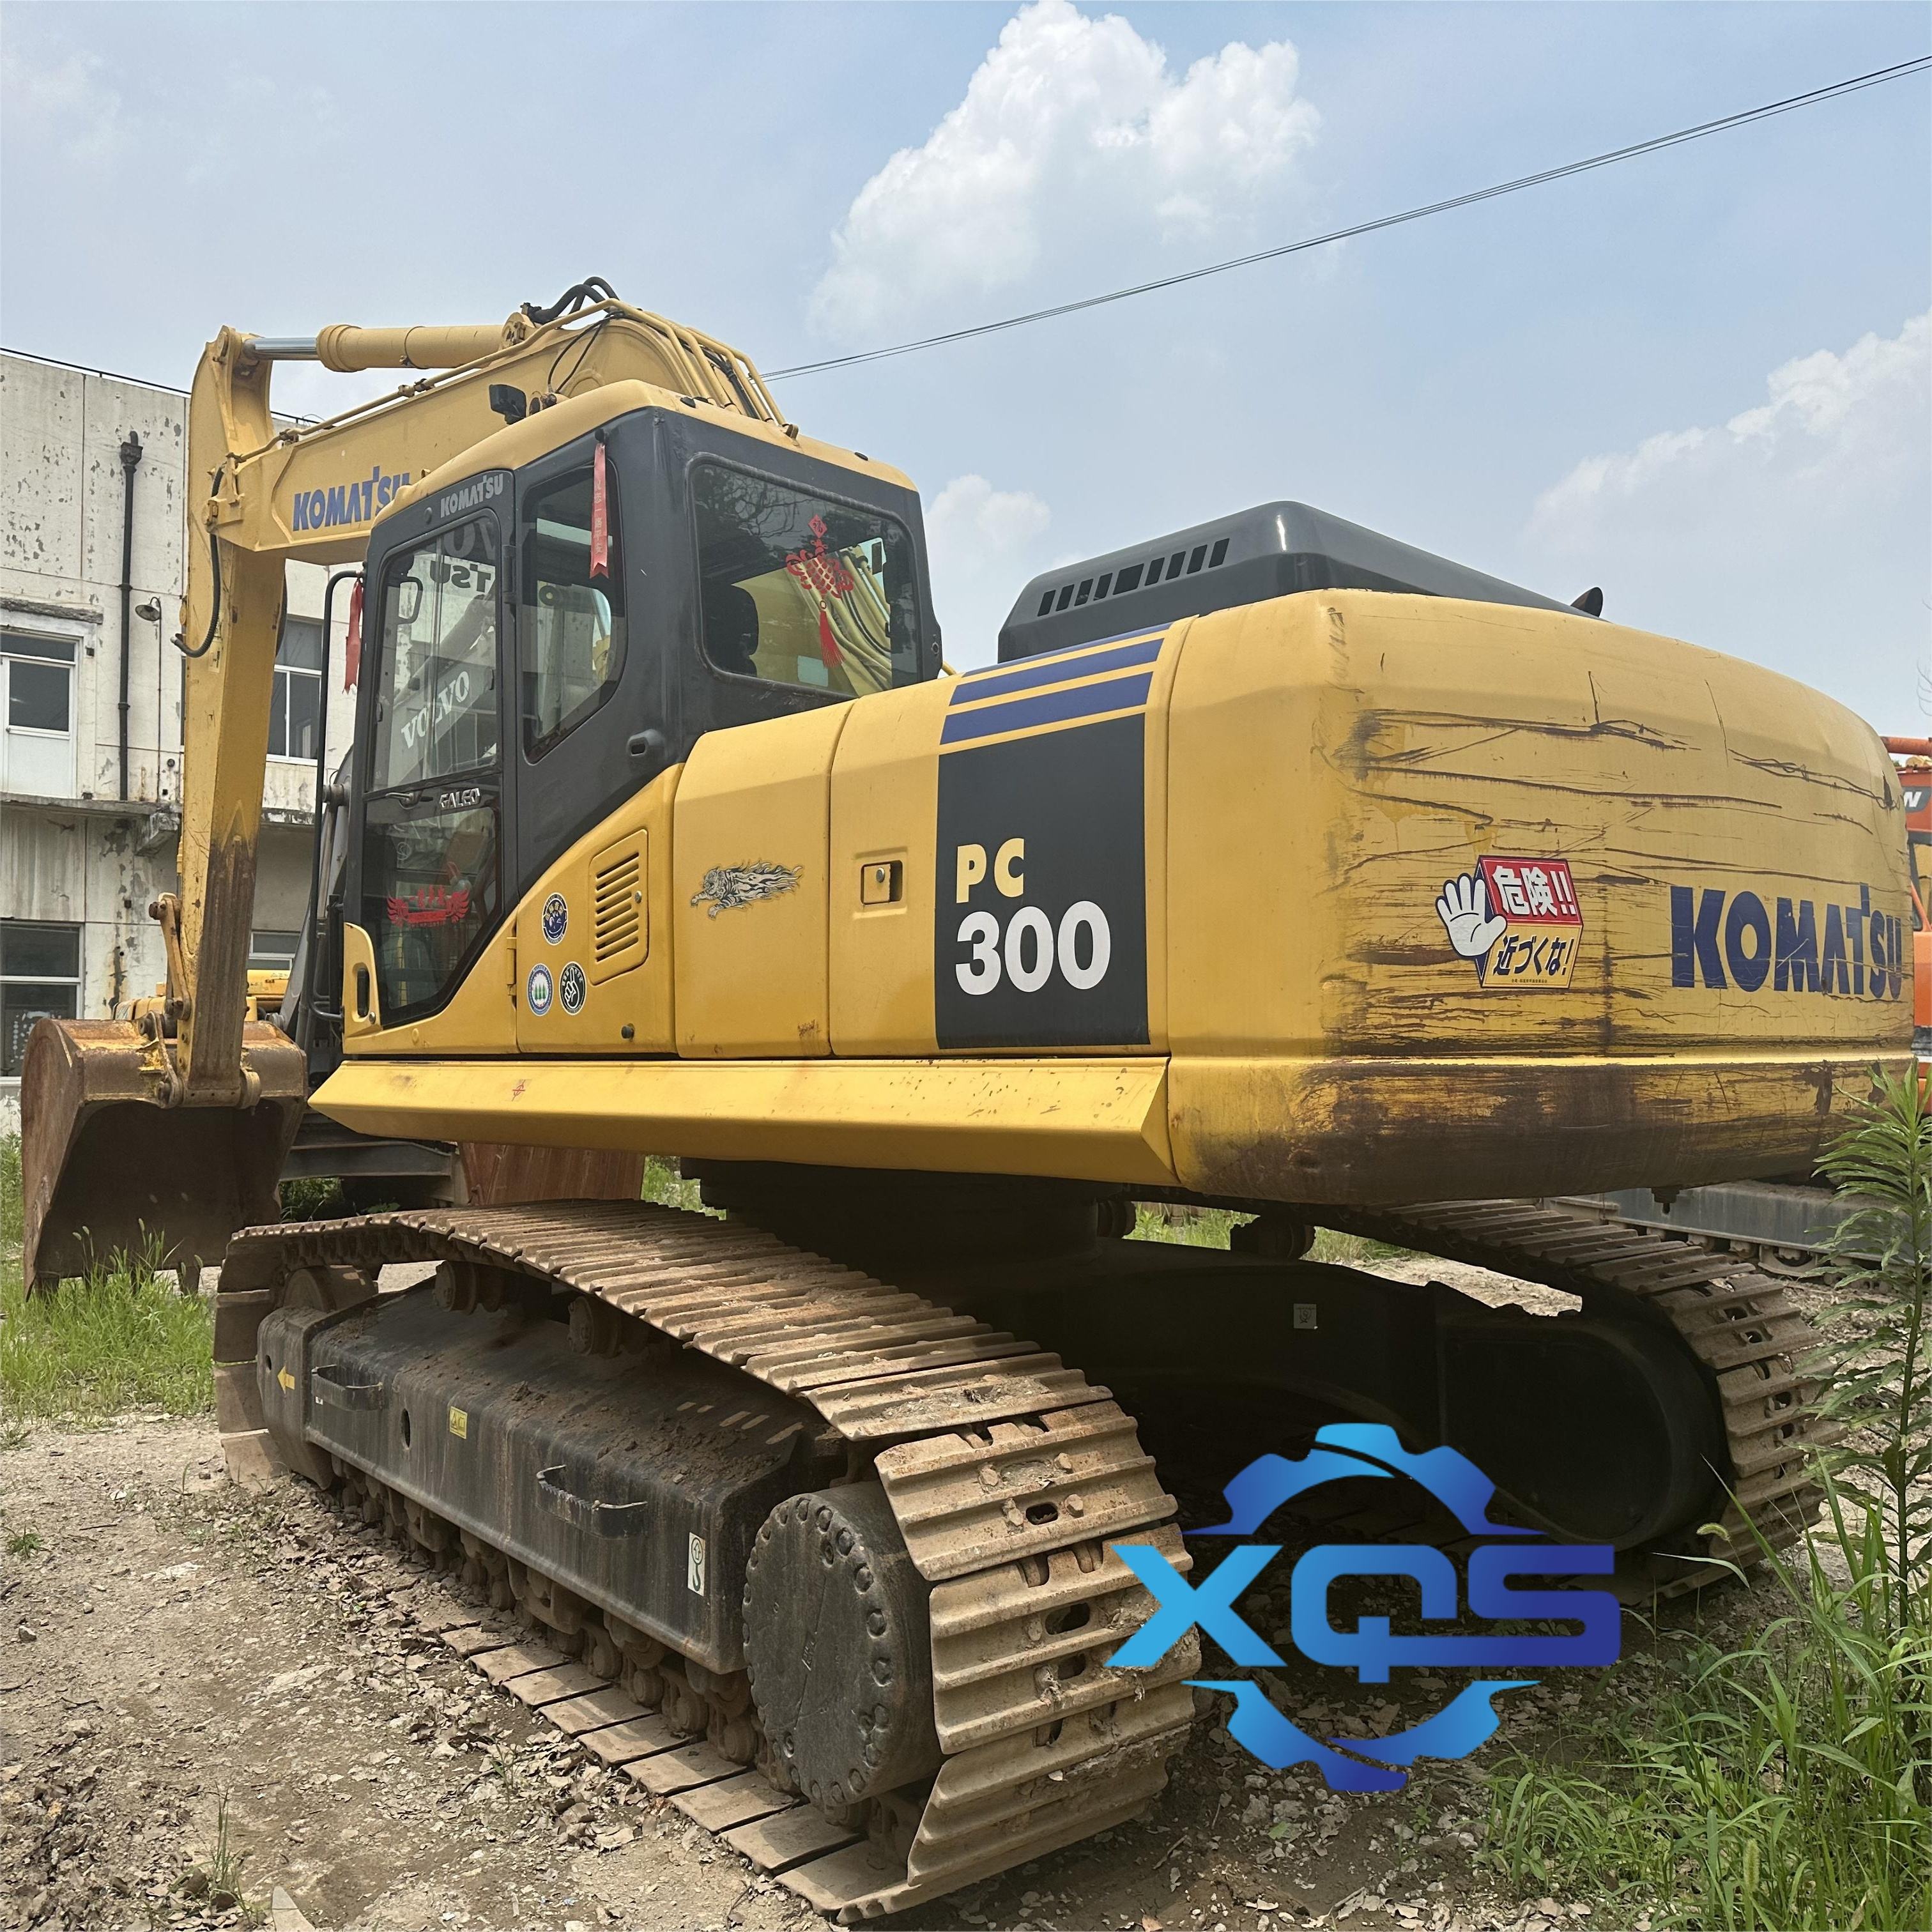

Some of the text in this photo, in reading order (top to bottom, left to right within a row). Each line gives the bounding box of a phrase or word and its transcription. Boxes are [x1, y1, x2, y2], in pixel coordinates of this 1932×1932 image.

[440, 474, 503, 518] KOMATSU
[401, 671, 470, 749] VOLVO
[440, 787, 480, 808] GALEO
[956, 838, 1025, 903] PC
[955, 900, 1111, 995] 300
[1670, 882, 1902, 1000] KOMATSU
